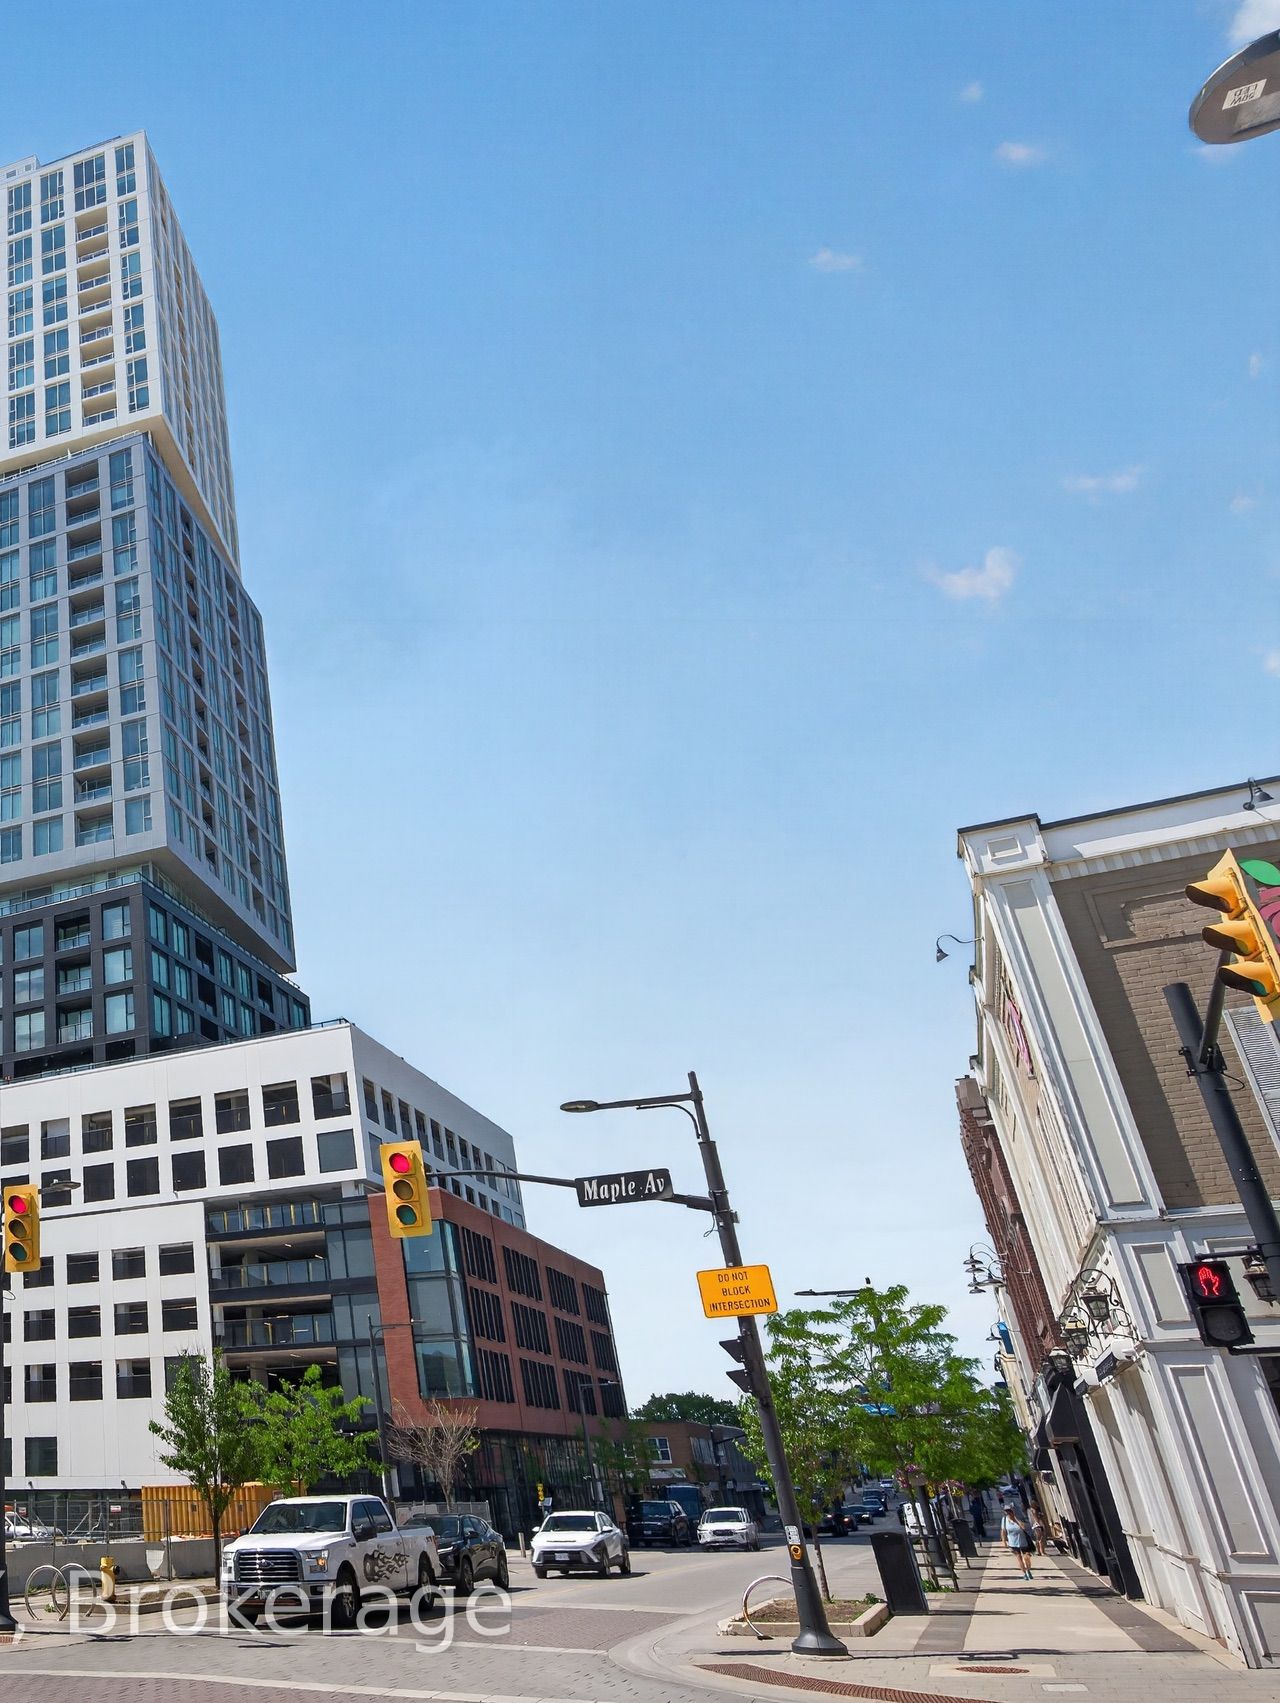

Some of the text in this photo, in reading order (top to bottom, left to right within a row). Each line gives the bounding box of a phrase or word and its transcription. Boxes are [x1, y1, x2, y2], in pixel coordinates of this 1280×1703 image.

[583, 1172, 665, 1202] Maple Av
[718, 1271, 748, 1283] DO NOT
[721, 1285, 751, 1296] BLOCK
[710, 1298, 770, 1312] INTERSECTION
